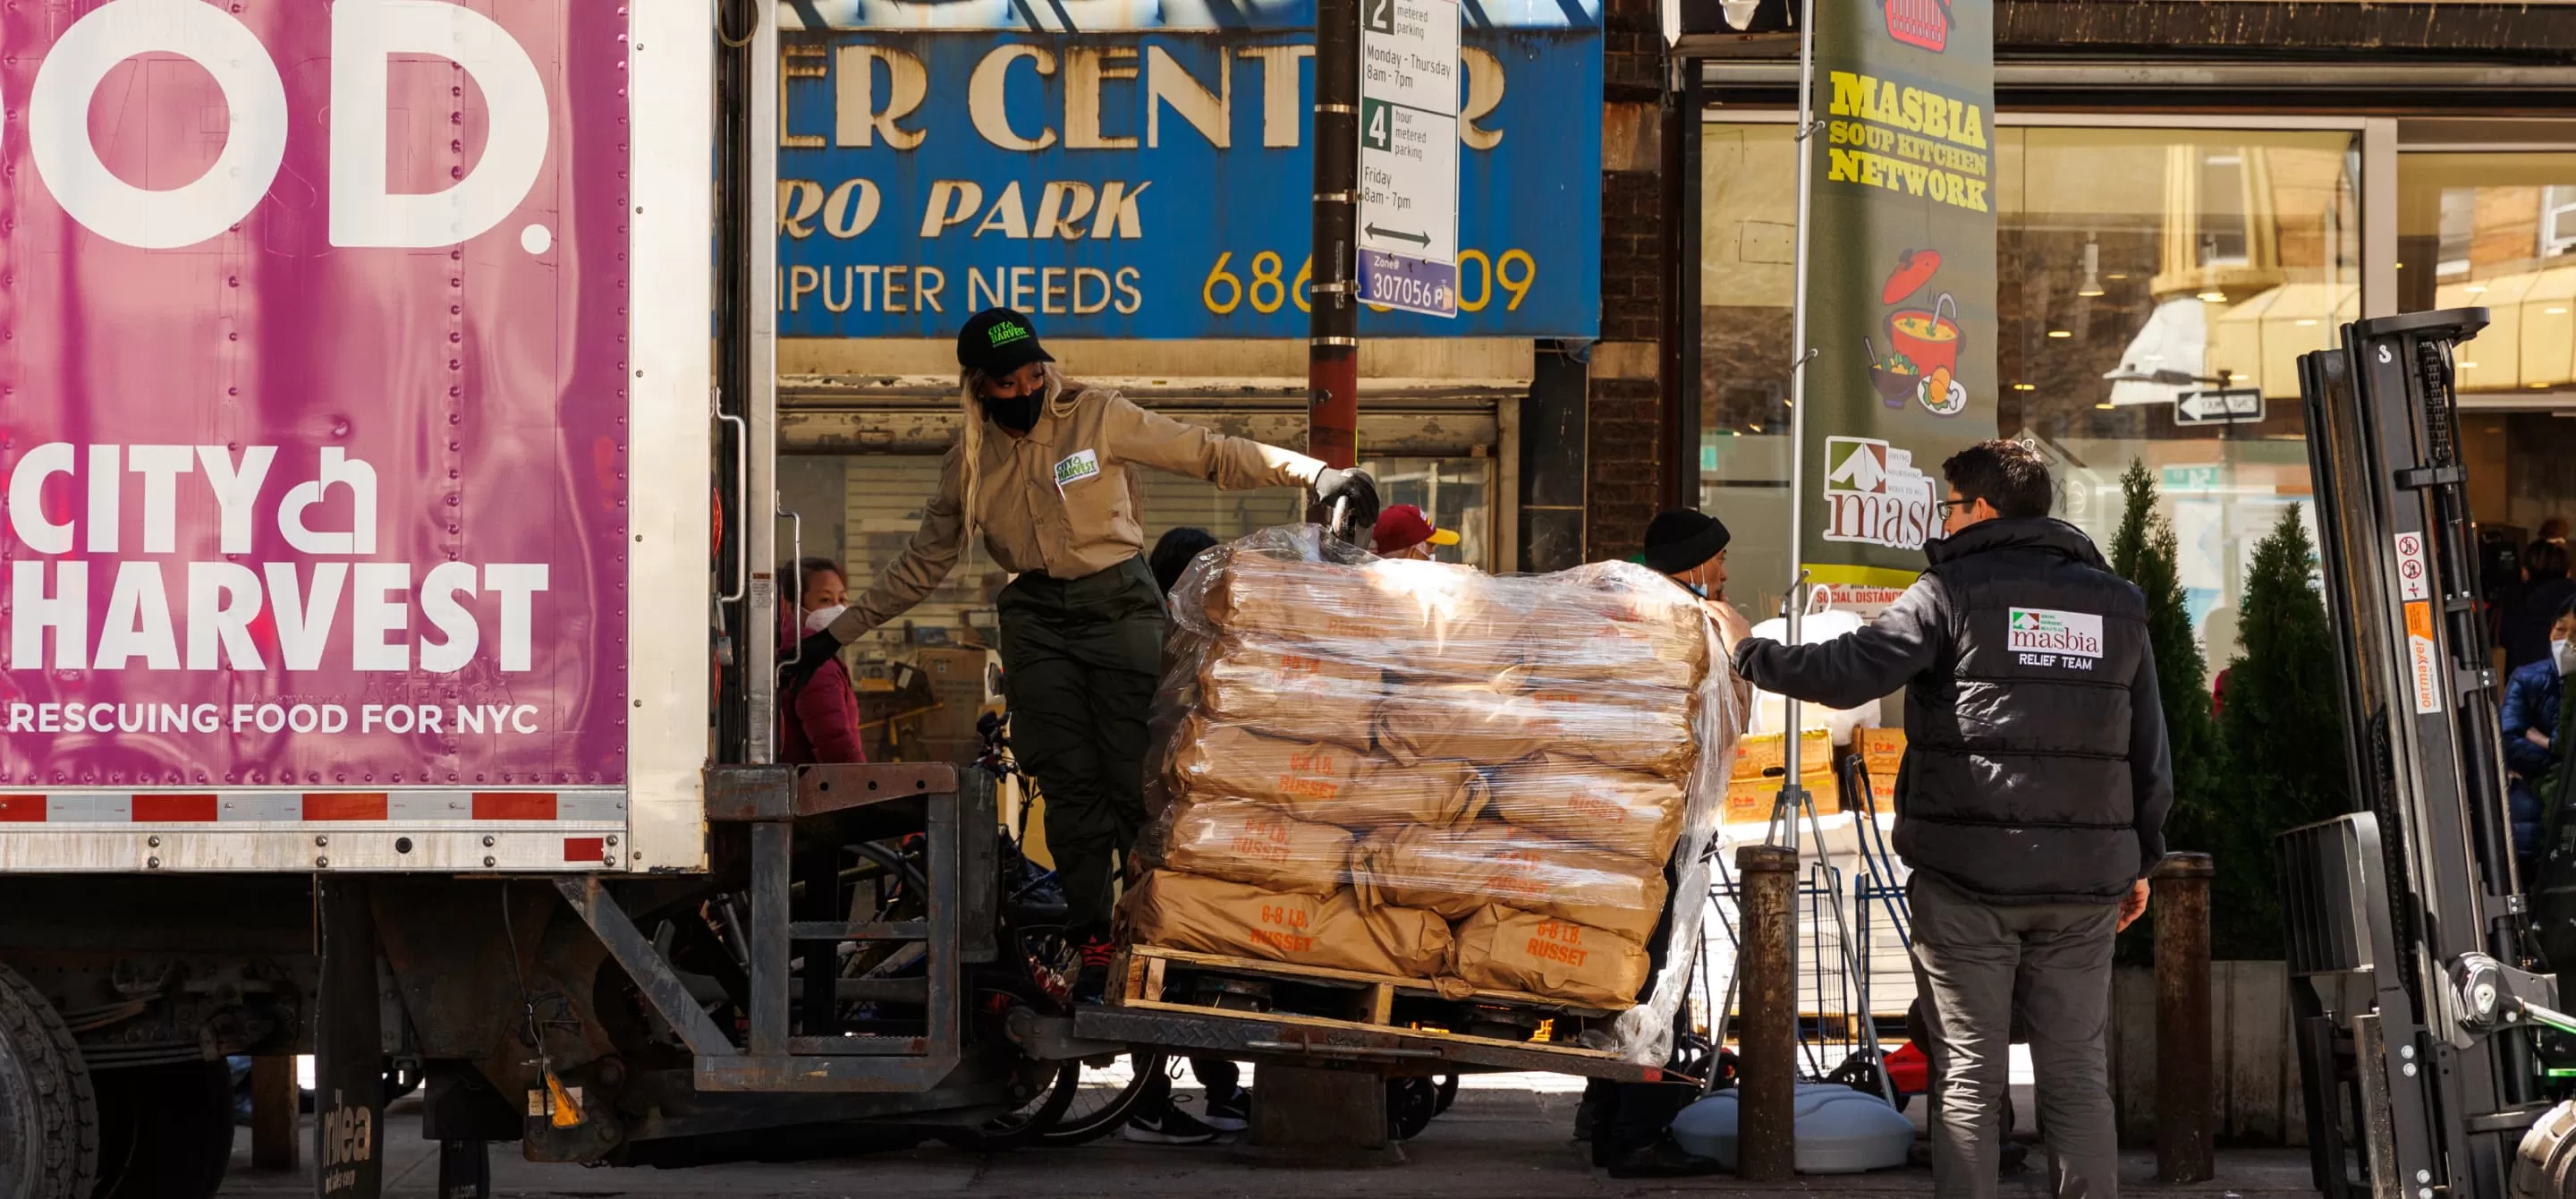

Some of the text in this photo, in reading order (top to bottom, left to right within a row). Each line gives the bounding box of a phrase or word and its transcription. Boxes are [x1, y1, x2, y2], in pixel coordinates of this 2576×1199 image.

[1372, 0, 1387, 30] 2
[1397, 6, 1428, 22] metered
[1396, 23, 1425, 41] parking
[1367, 44, 1402, 70] Monday
[1411, 54, 1452, 81] Thursday
[1367, 64, 1386, 83] 8am
[1394, 71, 1413, 89] 7pm
[968, 43, 1505, 151] CENTR
[1829, 71, 1987, 150] MASBIA
[0, 0, 552, 254] OD.
[1368, 106, 1386, 148] 4
[1395, 109, 1412, 125] hour
[1395, 127, 1427, 144] metered
[1828, 120, 1987, 177] SOUP KITCHEN
[1394, 144, 1423, 161] parking
[1364, 166, 1392, 190] Friday
[1828, 148, 1987, 213] NETWORK
[919, 180, 1153, 240] PARK
[1364, 187, 1384, 205] 8am
[1392, 191, 1411, 211] 7pm
[1373, 255, 1400, 270] Zone#
[778, 265, 1142, 314] PUTER NEEDS
[1373, 272, 1431, 308] 307056
[1056, 457, 1072, 472] CITY
[8, 442, 278, 555] CITY
[1827, 480, 1947, 547] masb
[1817, 591, 1903, 603] SOCIAL DISTANC
[11, 560, 548, 673] HARVEST
[2012, 626, 2100, 653] masbia
[2019, 653, 2093, 670] RELIEF TEAM
[11, 702, 538, 734] RESCUING FOOD FOR NYC
[1261, 905, 1309, 929] 6-8 LB.
[1538, 920, 1582, 946] 6-8 LB.
[1526, 937, 1589, 967] RUSSET
